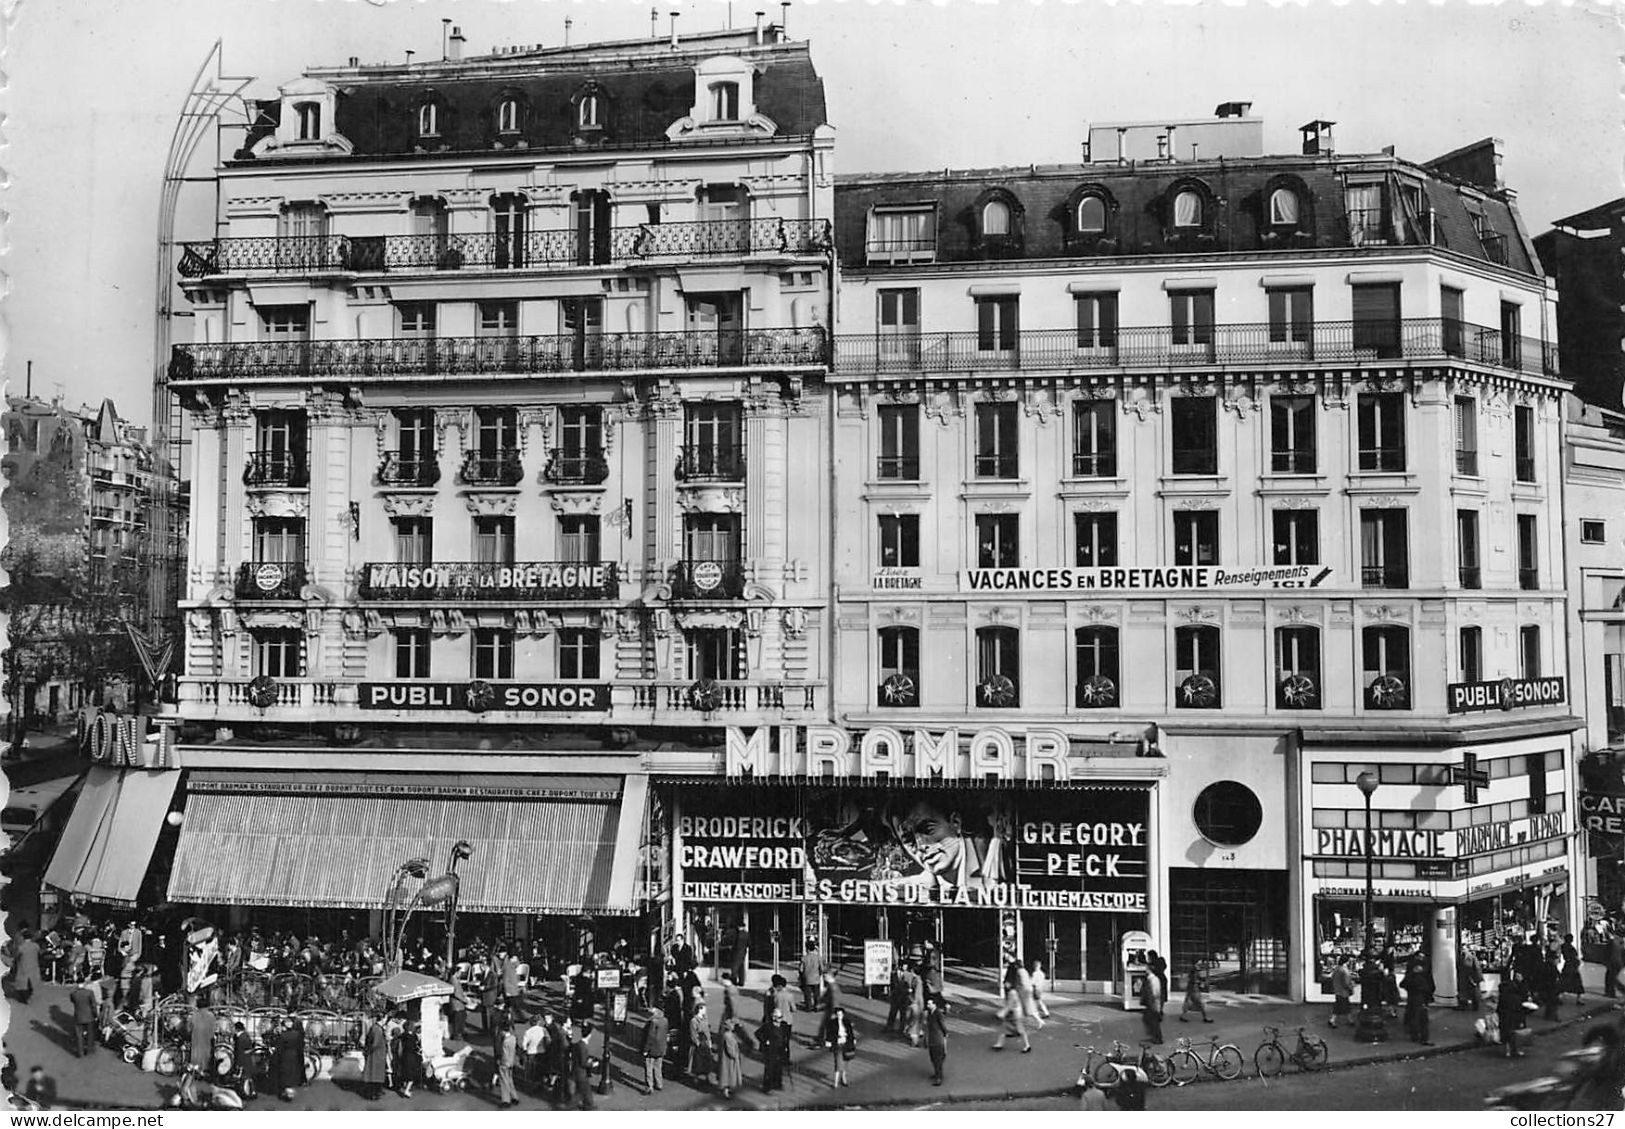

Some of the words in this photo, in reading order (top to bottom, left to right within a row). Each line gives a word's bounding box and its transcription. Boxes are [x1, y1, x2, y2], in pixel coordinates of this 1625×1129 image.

[370, 566, 450, 588] MAISON
[457, 573, 473, 588] DE
[480, 573, 495, 588] LA
[500, 565, 605, 588] BRETAGNE
[968, 569, 1072, 590] VACANCES
[1077, 574, 1095, 588] EN
[1100, 568, 1208, 588] BRETAGNE
[1214, 564, 1310, 586] Renseignements
[1273, 580, 1306, 588] ICI
[371, 686, 451, 706] PUBLI
[504, 688, 596, 707] SONOR
[1455, 686, 1499, 707] PUBLI
[1514, 681, 1560, 701] SONOR
[726, 725, 1071, 781] MIRAMAR
[680, 816, 803, 839] BRODERICK
[1023, 822, 1143, 846] GREGORY
[1317, 828, 1446, 858] PHARMACIE
[680, 845, 805, 869] CRAWFORD
[1047, 853, 1121, 877] PECK
[791, 878, 833, 901] LES
[841, 879, 899, 901] GENS
[904, 883, 930, 903] DE
[940, 882, 971, 905] LA
[978, 881, 1031, 907] NUIT
